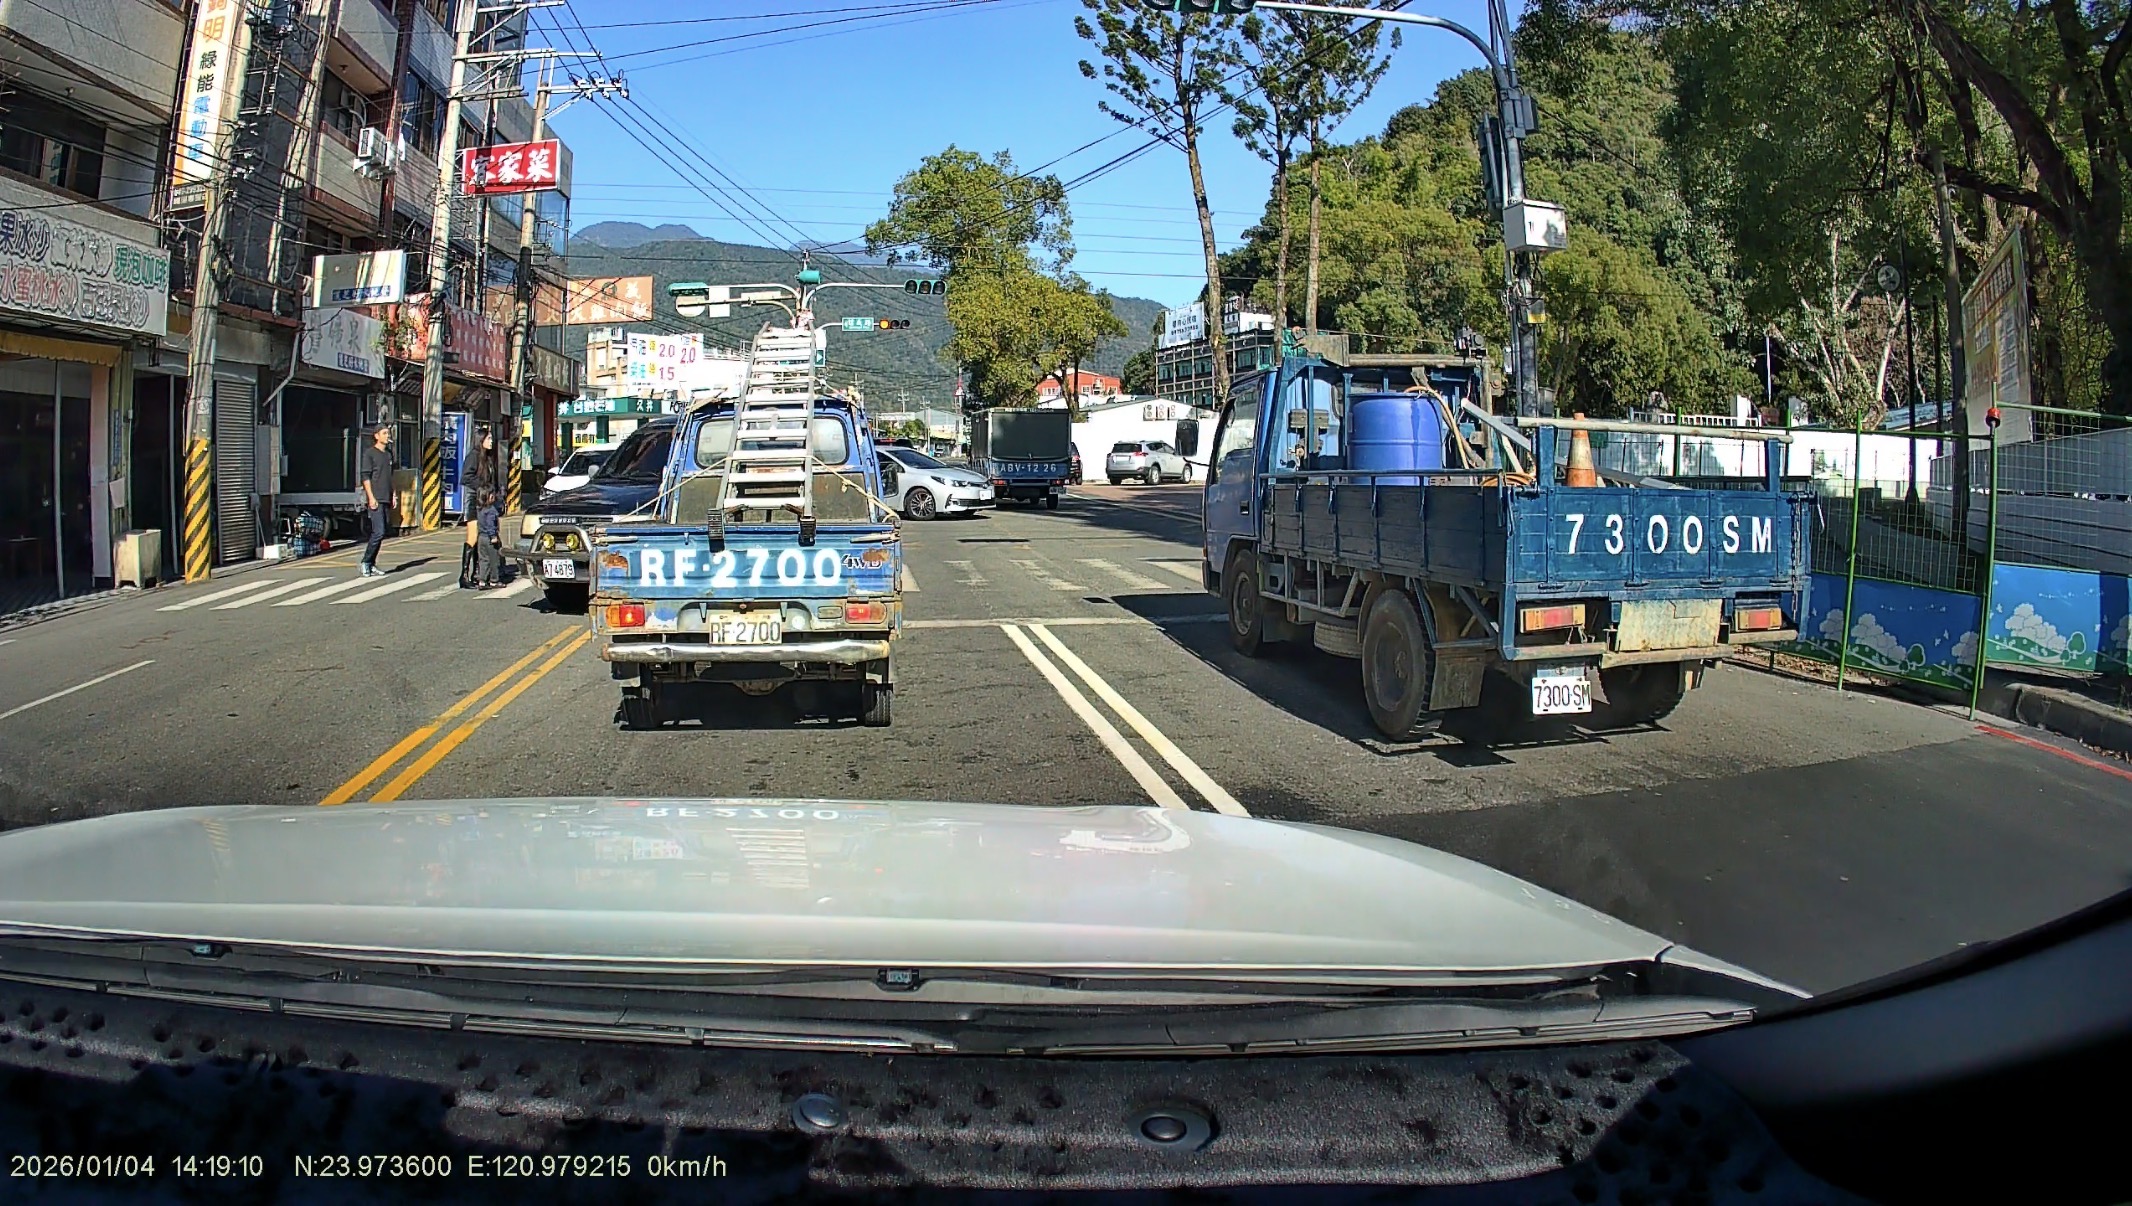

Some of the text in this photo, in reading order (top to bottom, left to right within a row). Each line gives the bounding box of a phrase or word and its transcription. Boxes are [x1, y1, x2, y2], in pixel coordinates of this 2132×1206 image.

[469, 148, 553, 186] 客家菜
[113, 243, 169, 294] 現泡咖啡
[841, 553, 883, 569] 4WD
